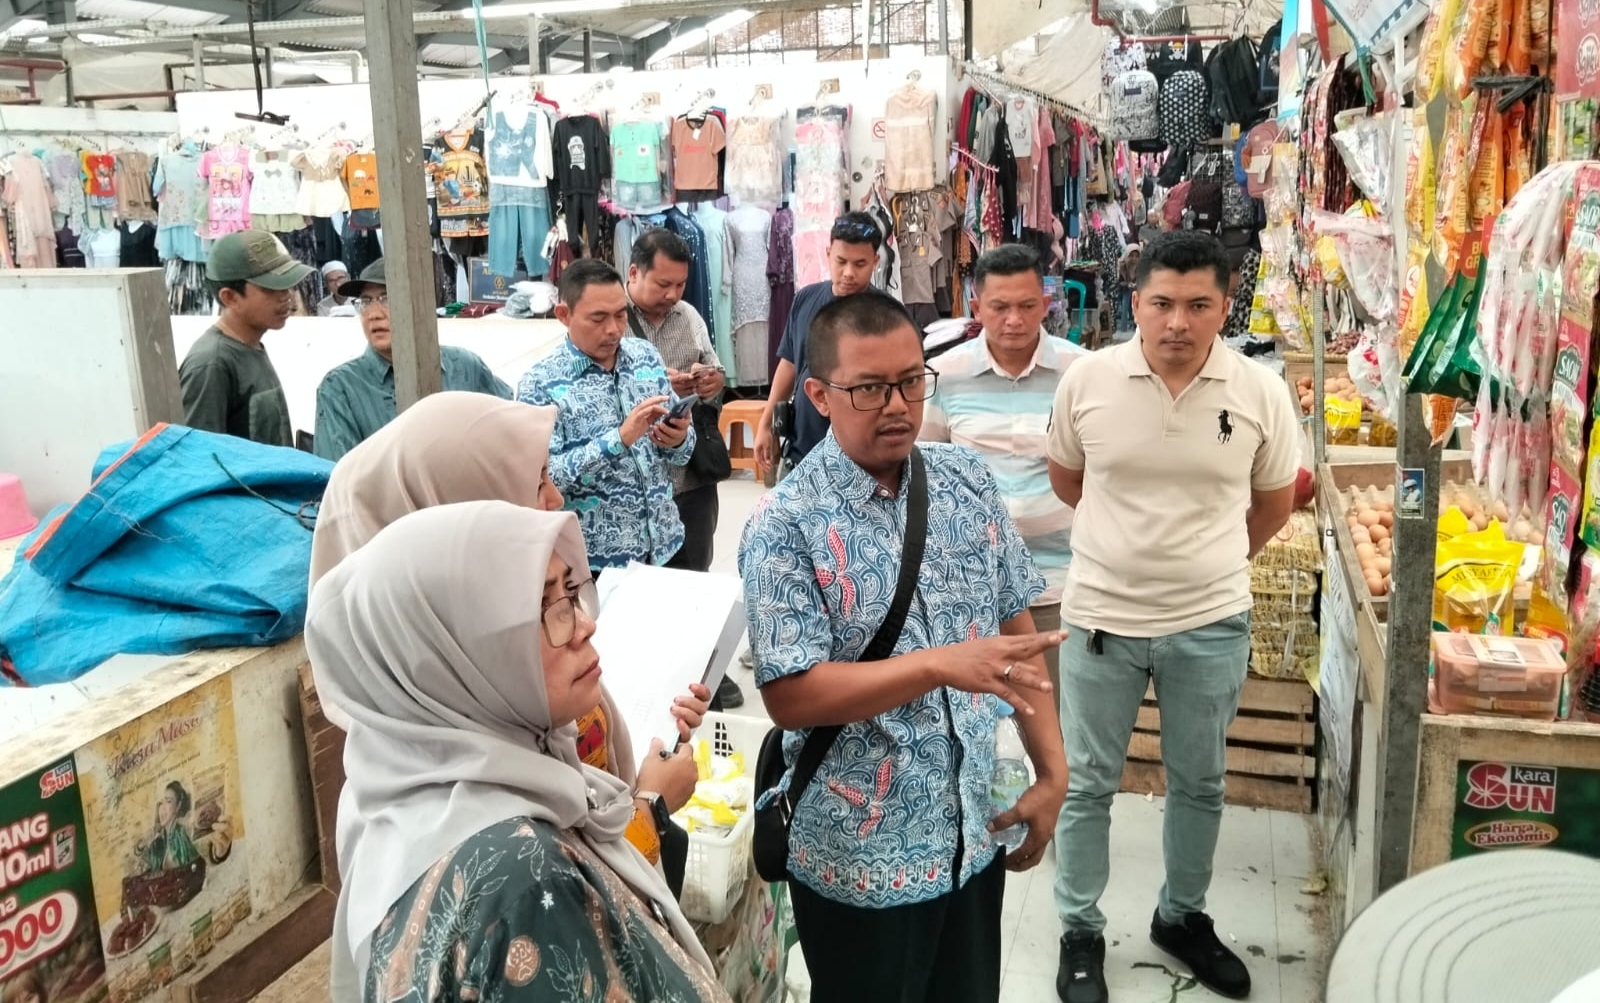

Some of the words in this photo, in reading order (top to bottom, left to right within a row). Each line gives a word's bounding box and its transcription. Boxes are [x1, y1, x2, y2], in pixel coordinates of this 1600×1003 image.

[1514, 767, 1551, 784] kara
[40, 770, 75, 799] SUN
[1464, 762, 1555, 814] SUN
[1476, 830, 1552, 845] Ekonomis
[1491, 822, 1535, 836] Harga
